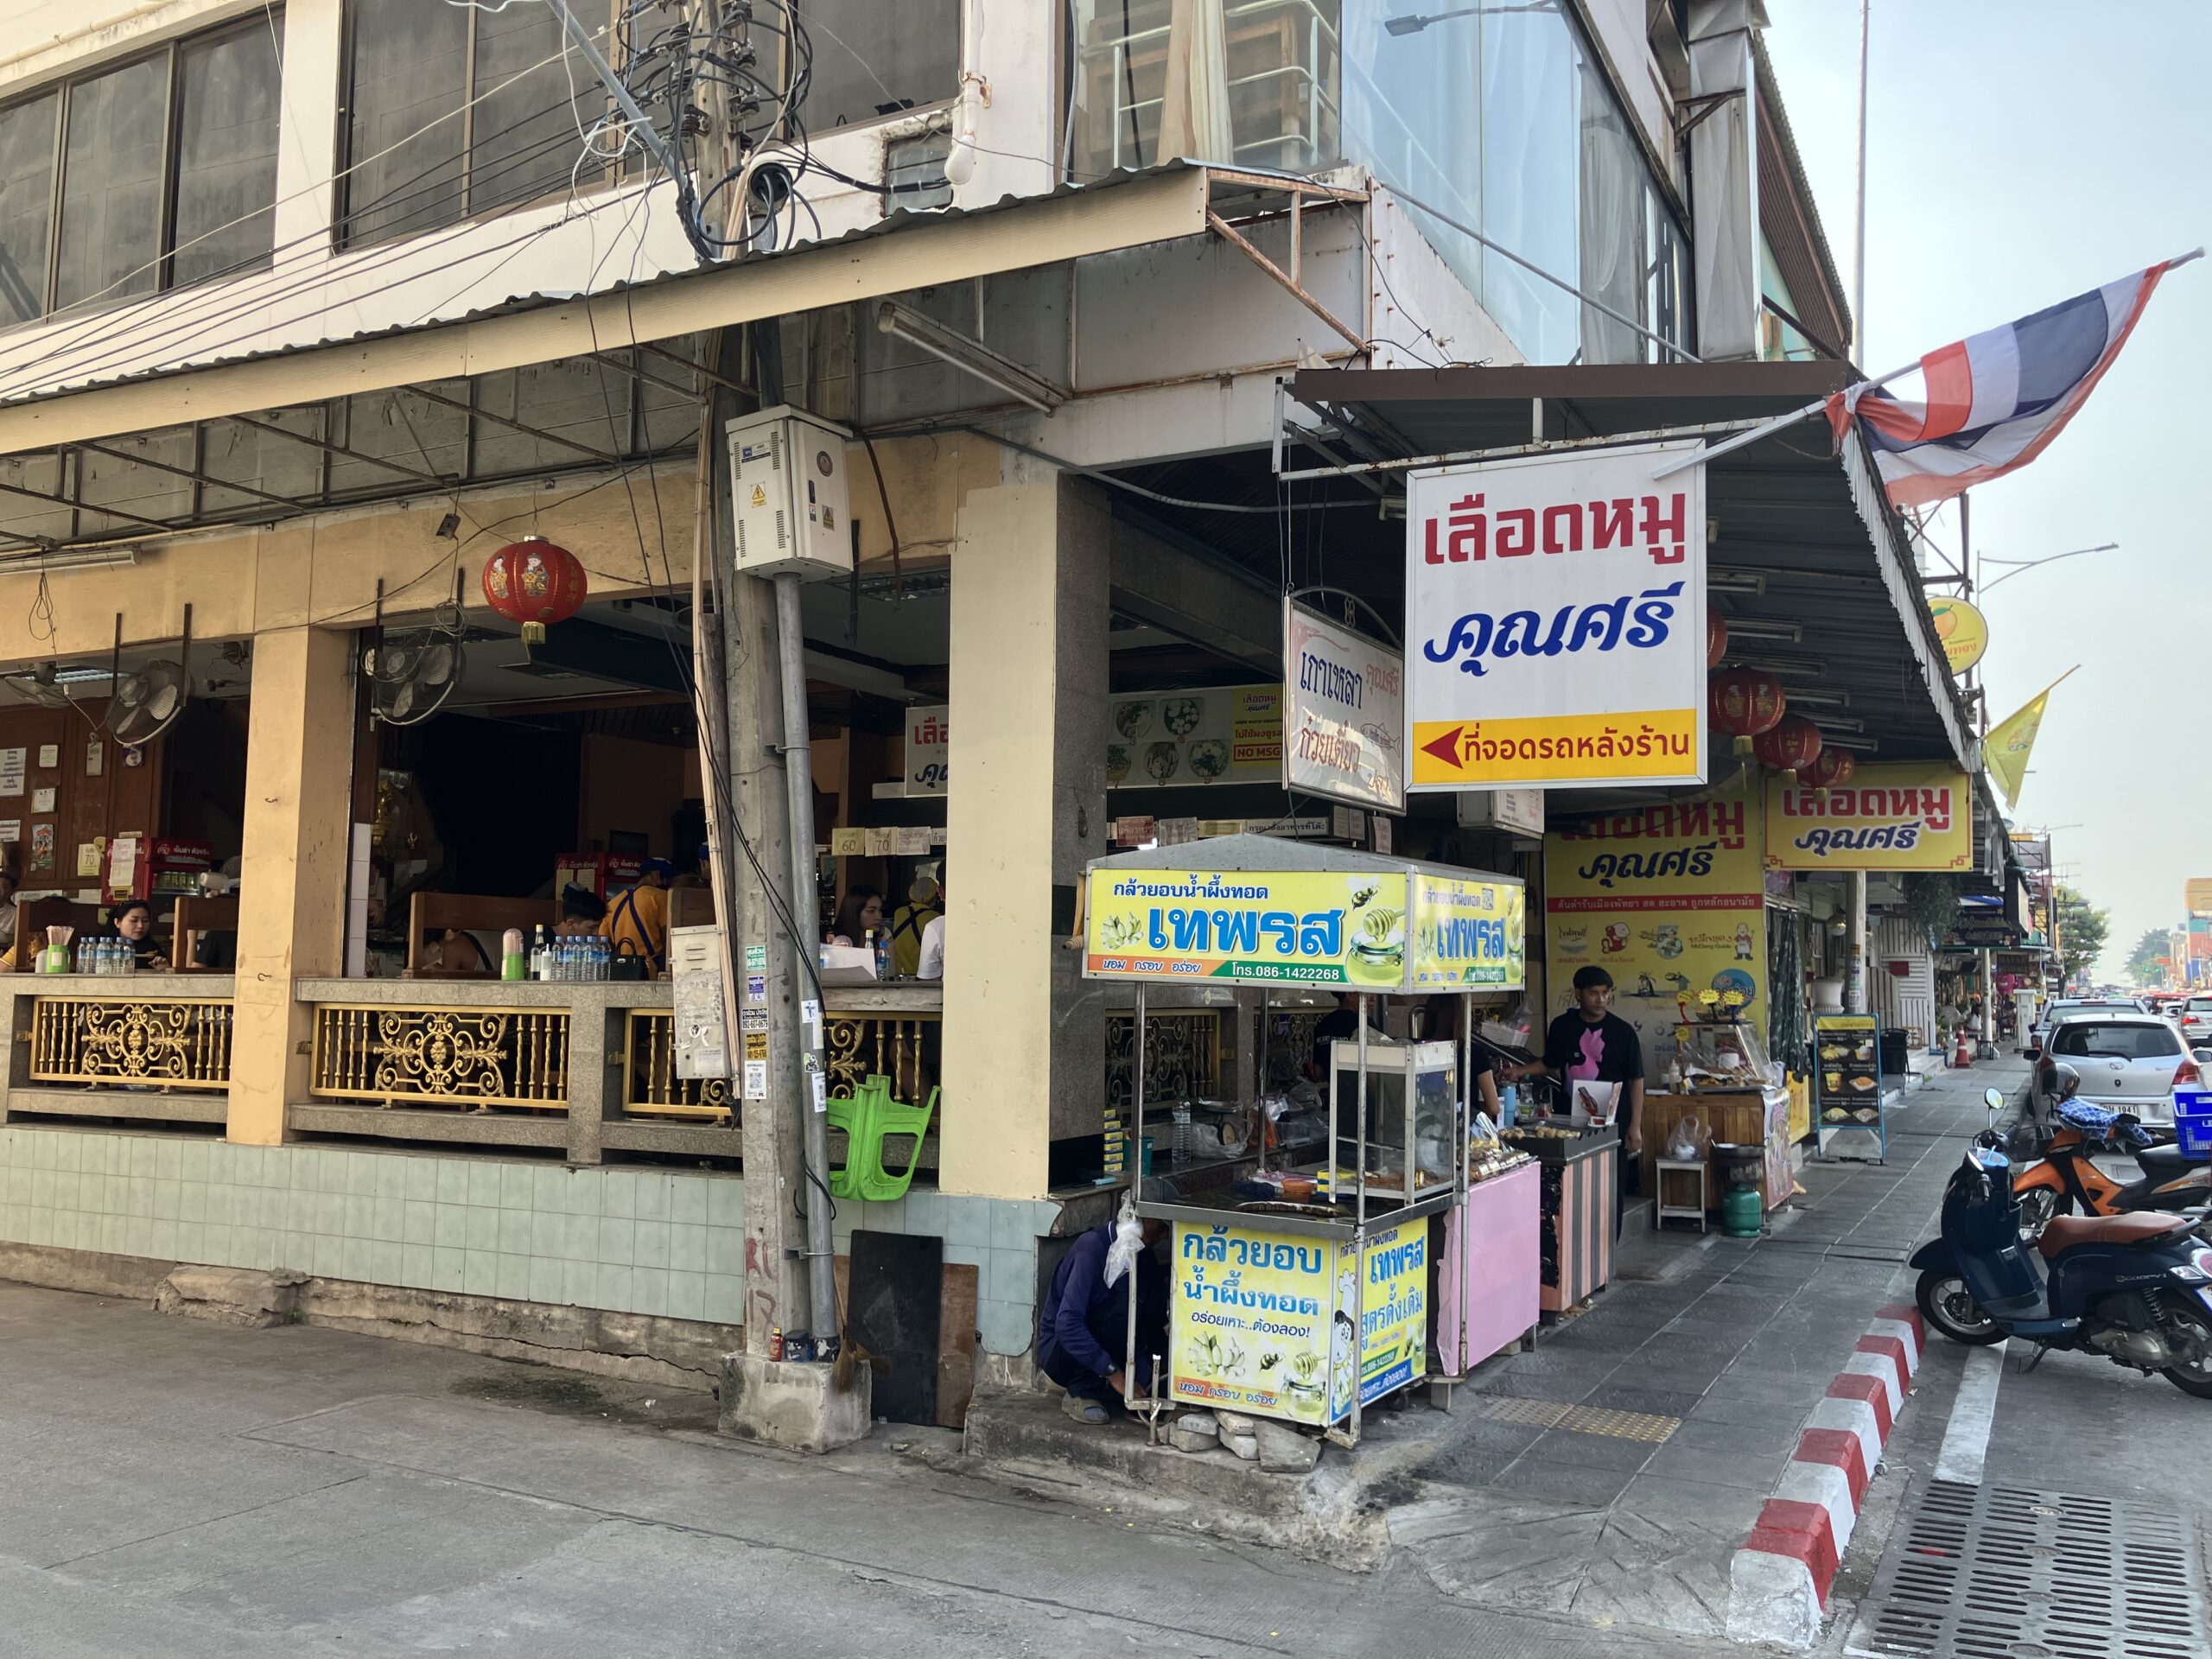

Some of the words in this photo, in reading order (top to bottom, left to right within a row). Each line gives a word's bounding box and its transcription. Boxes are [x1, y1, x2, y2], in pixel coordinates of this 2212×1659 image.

[1424, 492, 1687, 565] เลือดหมู
[1423, 580, 1687, 677] คุณศรี
[1300, 650, 1363, 709] เกาเหลา
[1237, 747, 1254, 758] NO
[1256, 747, 1281, 757] MSG
[1464, 721, 1689, 763] ที่จอดรถหลังร้าน
[842, 840, 856, 852] 60
[875, 839, 890, 852] 70
[1795, 821, 1922, 856] คุณศรี
[1580, 842, 1718, 888] คุณศรี
[1113, 874, 1268, 900] กล้วยอบน้ำผึ้งทอด
[1147, 906, 1345, 957] เทพรส
[1436, 917, 1507, 961] เทพรส
[1103, 958, 1126, 971] หอม
[1134, 959, 1163, 973] กรอบ
[1171, 959, 1202, 975] อร่อย
[1231, 961, 1340, 982] โทร.086-1422268
[1183, 1222, 1322, 1274] กล้วยอบ
[1370, 1235, 1425, 1285] เทพรส
[1183, 1265, 1319, 1316] น้ำผึ้งทอด
[1179, 1381, 1204, 1394] หอม
[1209, 1386, 1241, 1401] กรอบ
[1245, 1390, 1277, 1406] อร่อย
